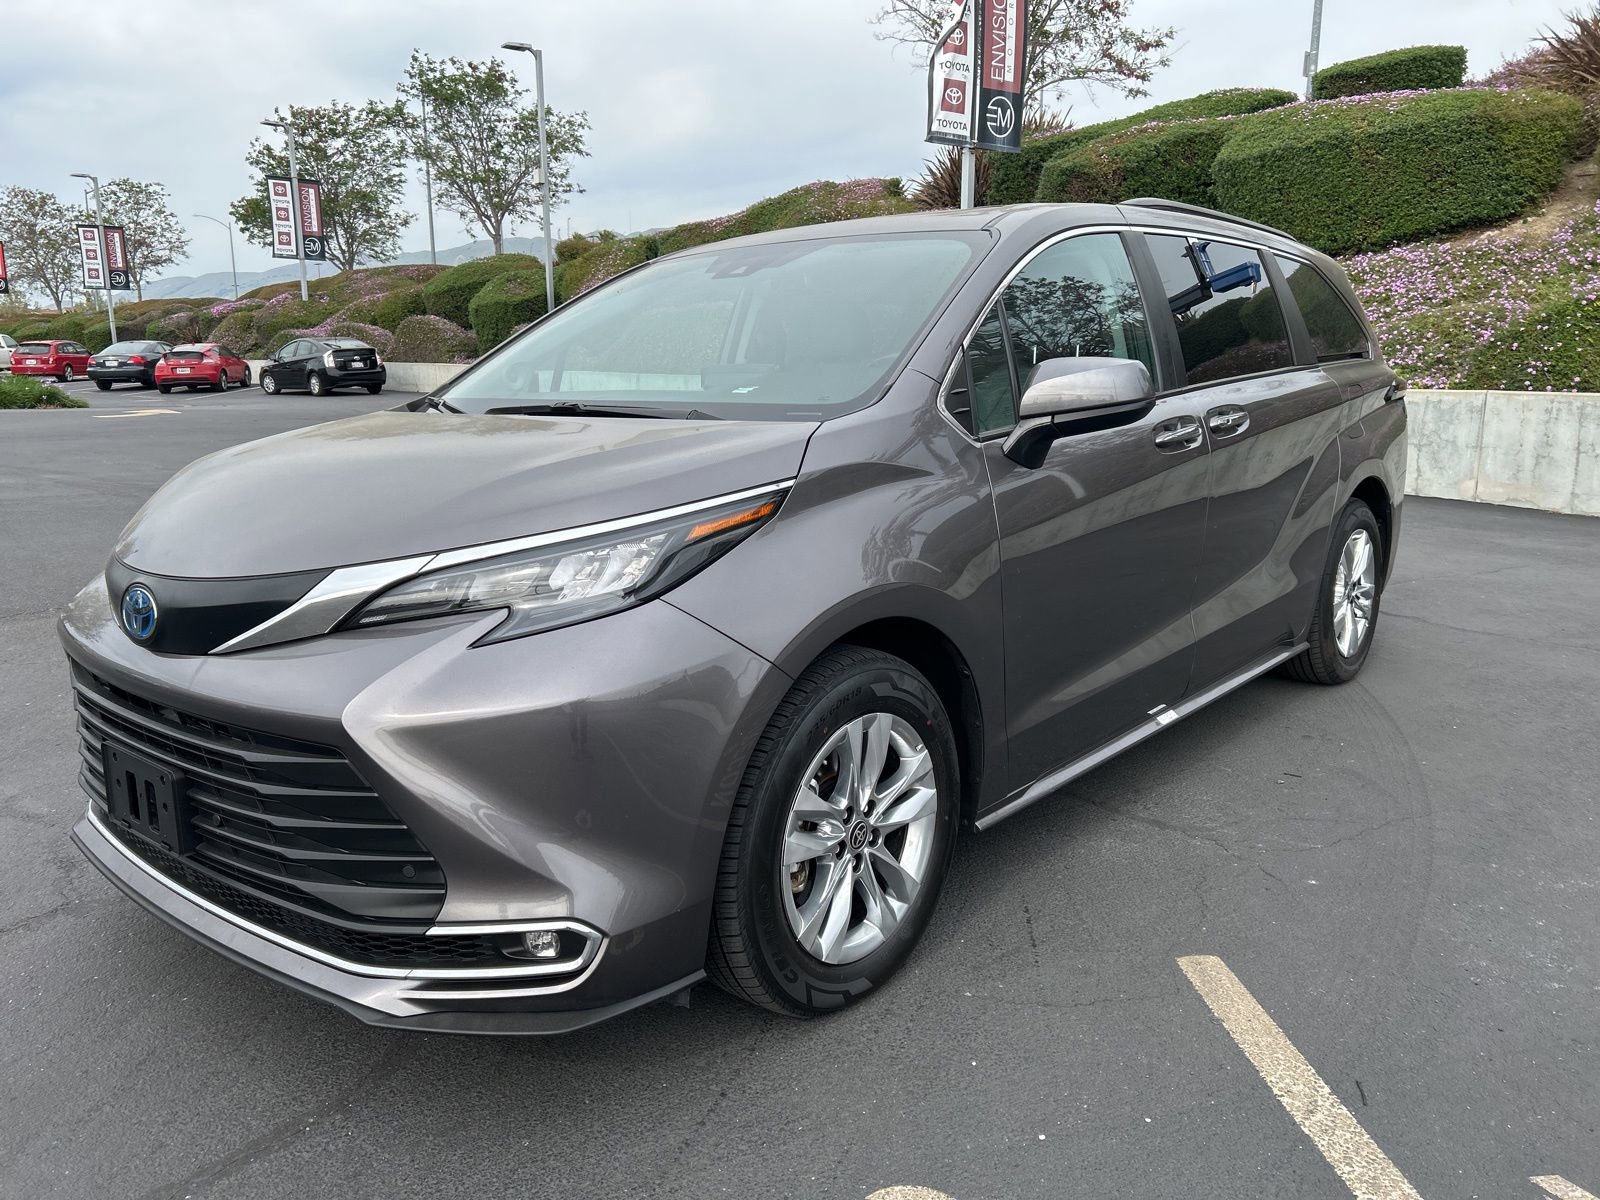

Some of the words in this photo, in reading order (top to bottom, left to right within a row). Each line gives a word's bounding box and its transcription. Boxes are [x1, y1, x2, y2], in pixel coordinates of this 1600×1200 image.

[939, 60, 970, 73] TOYOTA
[936, 118, 968, 131] TOYOTA
[302, 187, 311, 232] ENVISION
[107, 232, 118, 268] ENVISION
